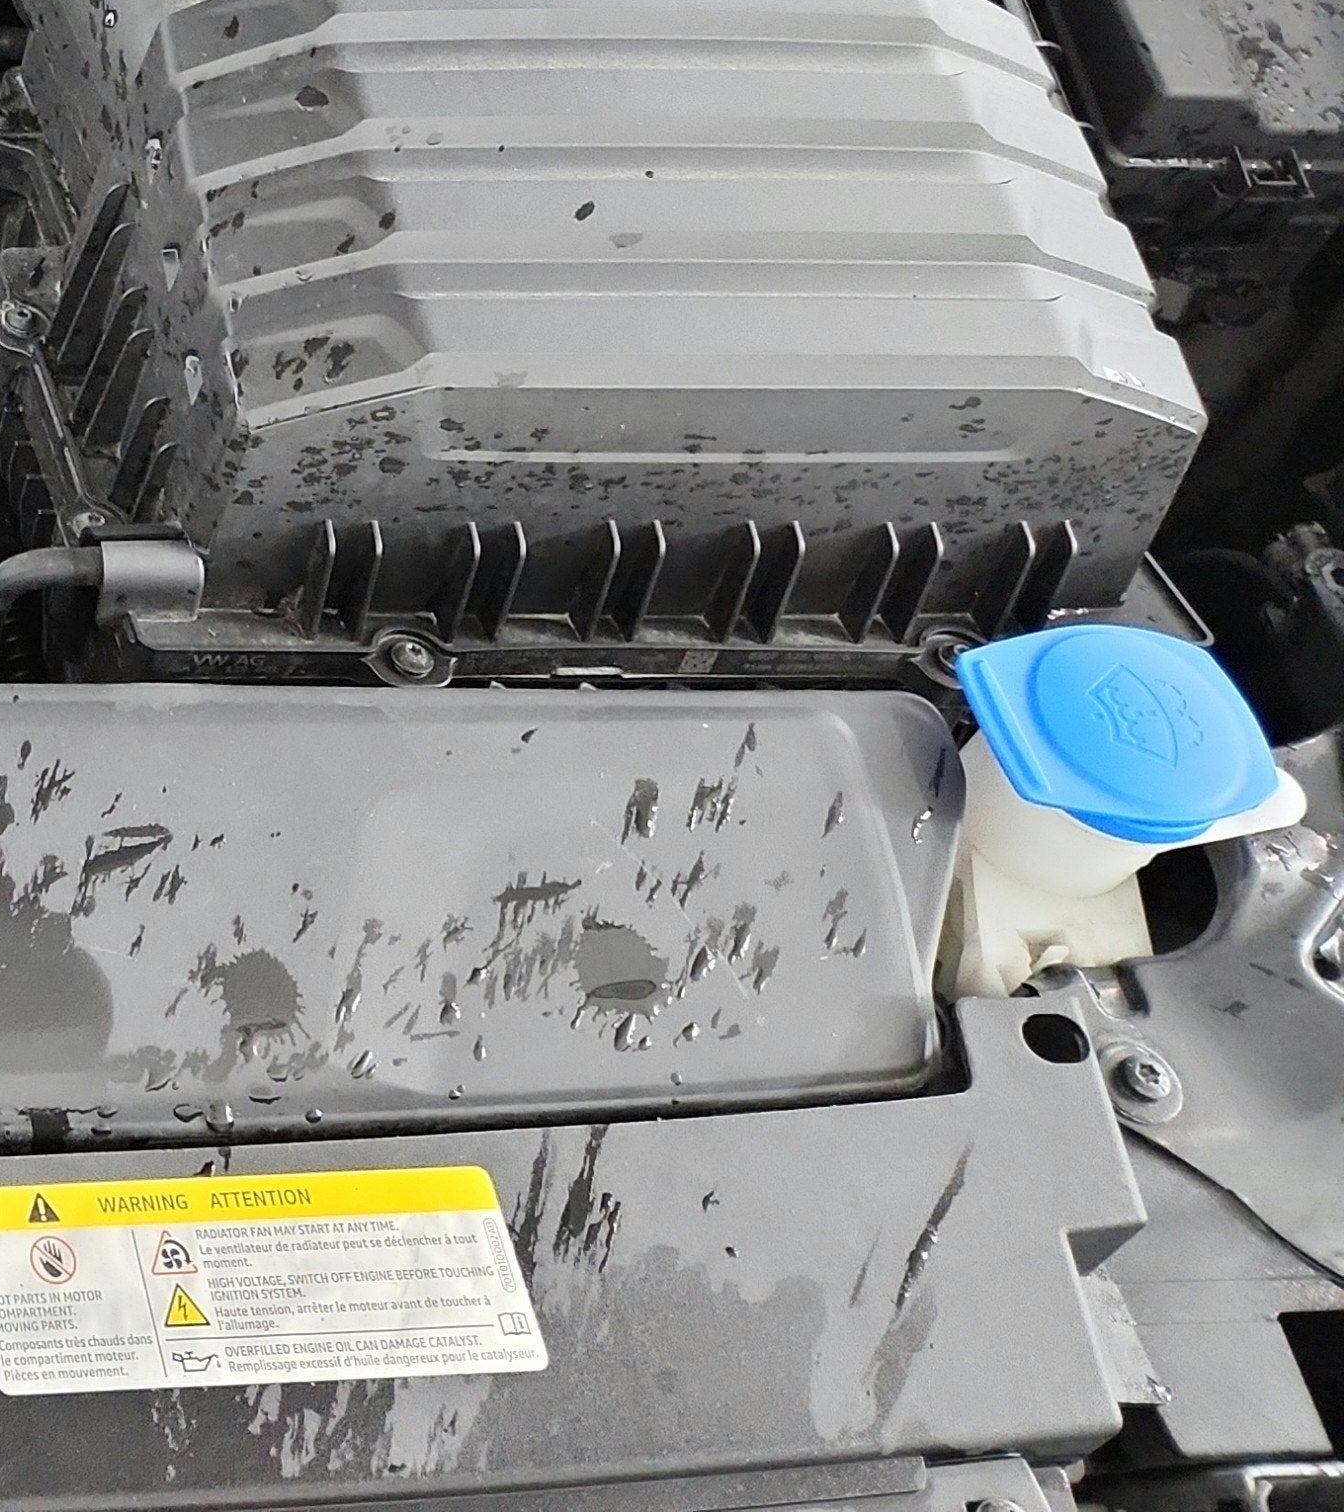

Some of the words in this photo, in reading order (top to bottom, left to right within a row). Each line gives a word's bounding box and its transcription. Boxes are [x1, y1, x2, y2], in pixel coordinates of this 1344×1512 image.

[96, 1193, 189, 1214] WARNING
[210, 1188, 312, 1209] ATTENTION
[194, 1227, 250, 1240] RADIATOR
[249, 1226, 273, 1238] FAN
[272, 1225, 296, 1237] MAY
[297, 1223, 330, 1236] START
[332, 1222, 345, 1234] AT
[347, 1221, 369, 1233] ANY
[369, 1220, 400, 1232] TIME.
[198, 1244, 213, 1256] Le
[213, 1242, 273, 1255] ventilateur
[274, 1240, 290, 1253] de
[290, 1239, 341, 1252] radiateur
[341, 1238, 369, 1252] peut
[369, 1238, 383, 1248] se
[383, 1234, 443, 1248] déclencher
[443, 1233, 453, 1245] à
[452, 1233, 478, 1245] tout
[202, 1257, 253, 1269] moment.
[206, 1276, 236, 1289] HIGH
[234, 1274, 287, 1288] VOLTAGE,
[286, 1272, 330, 1286] SWITCH
[330, 1271, 353, 1284] OFF
[352, 1269, 395, 1282] ENGINE
[394, 1267, 439, 1281] BEFORE
[437, 1265, 495, 1278] TOUCHING
[12, 1292, 48, 1306] PARTS
[48, 1291, 62, 1304] IN
[62, 1289, 104, 1303] MOTOR
[210, 1289, 260, 1302] IGNITION
[260, 1287, 307, 1300] SYSTEM.
[40, 1318, 79, 1332] PARTS.
[64, 1335, 87, 1349] très
[87, 1333, 127, 1348] chauds
[126, 1333, 154, 1346] dans
[224, 1343, 291, 1358] OVERFILLED
[291, 1341, 335, 1354] ENGINE
[334, 1340, 356, 1353] OIL
[354, 1339, 380, 1352] CAN
[379, 1336, 428, 1351] DAMAGE
[428, 1334, 483, 1348] CATALYST.
[0, 1354, 12, 1367] le
[13, 1351, 94, 1367] compartiment
[94, 1350, 139, 1363] moteur.
[3, 1368, 40, 1382] Pièces
[41, 1370, 57, 1381] en
[57, 1365, 129, 1379] mouvement.
